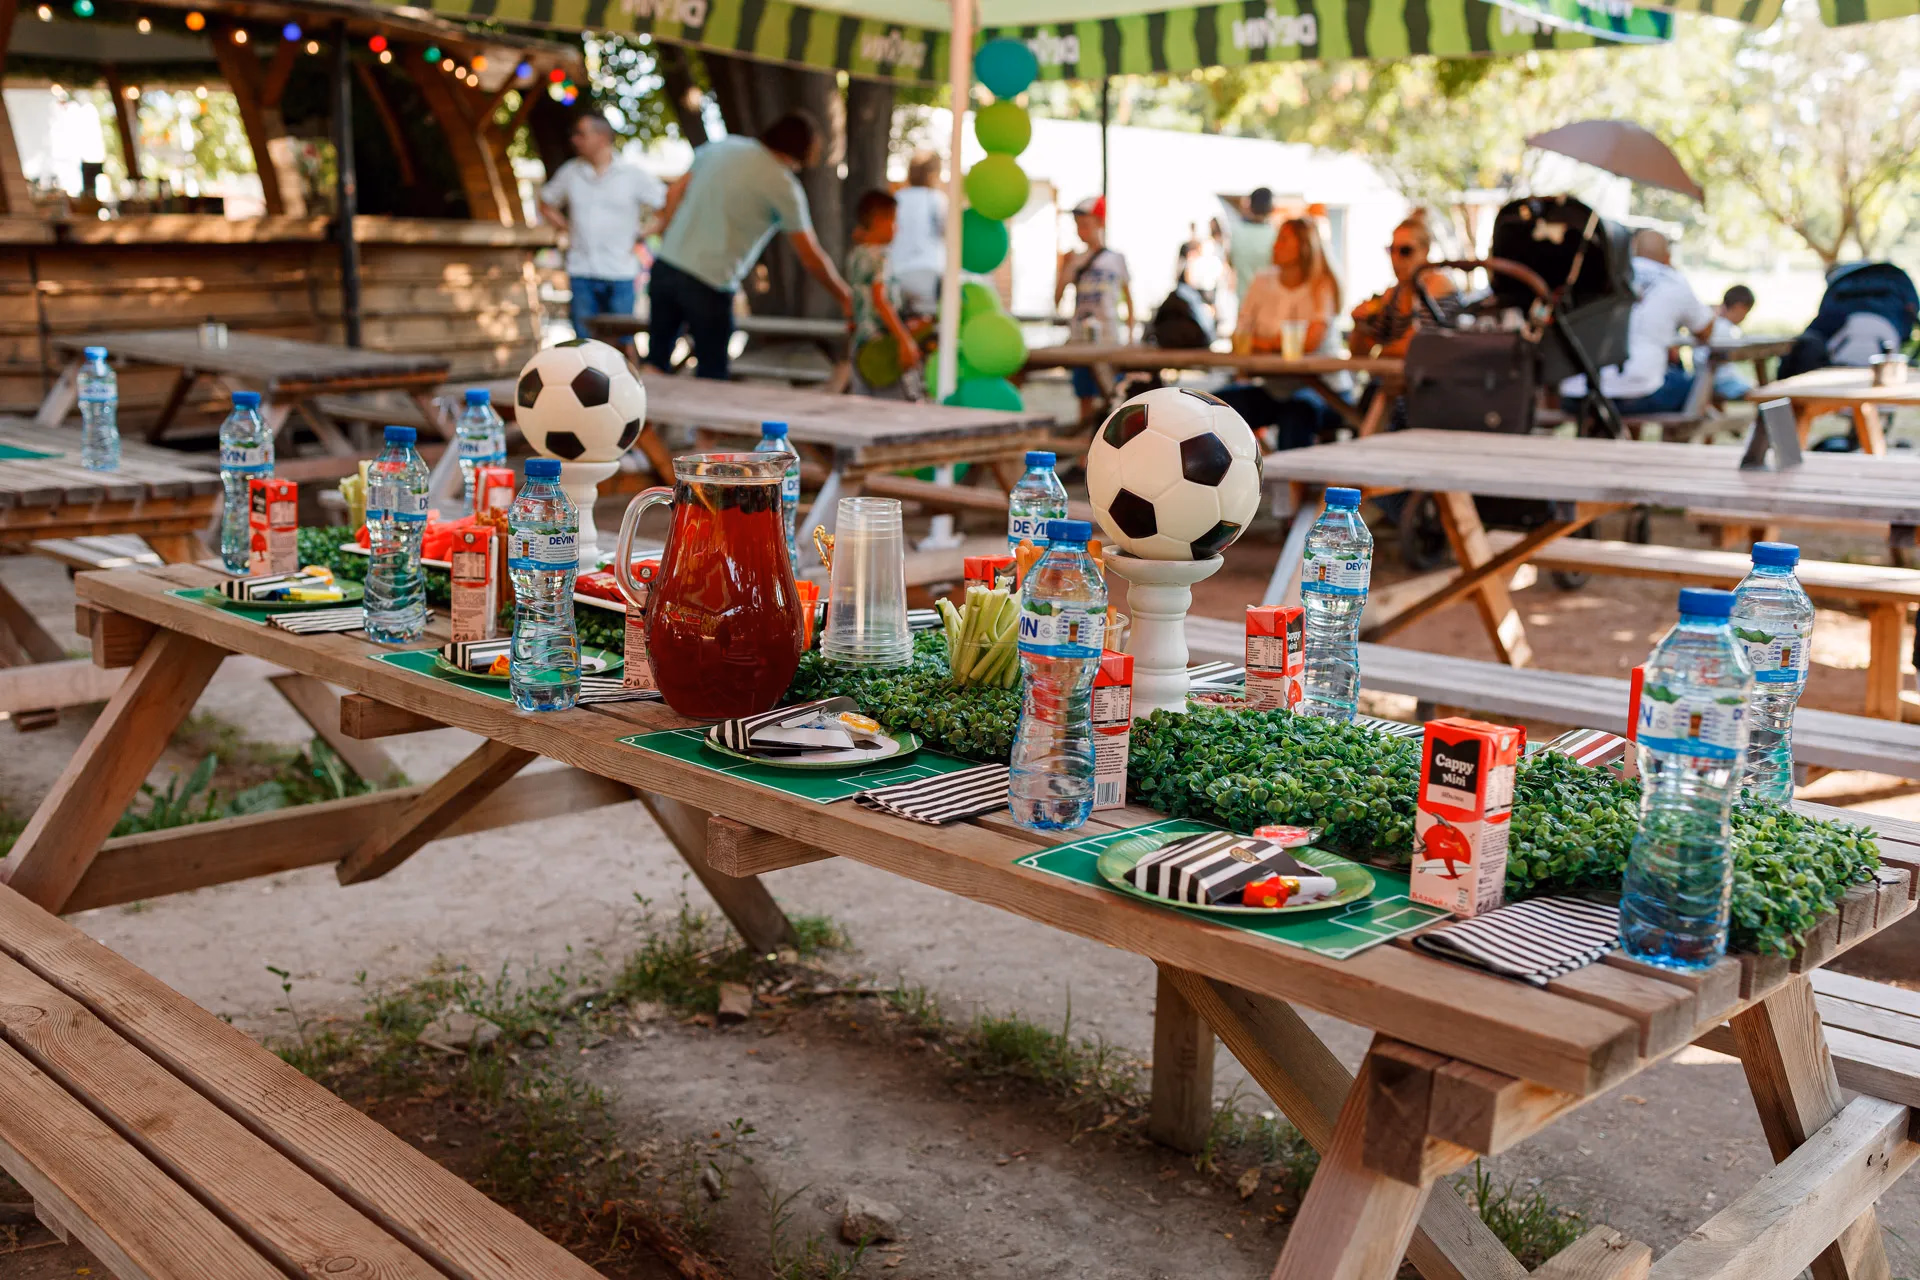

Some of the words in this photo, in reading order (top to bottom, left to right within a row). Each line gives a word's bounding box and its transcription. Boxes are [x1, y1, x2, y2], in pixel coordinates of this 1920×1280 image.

[549, 535, 575, 546] DEVIN
[1435, 753, 1475, 776] Cappy
[1442, 773, 1466, 787] Mini
